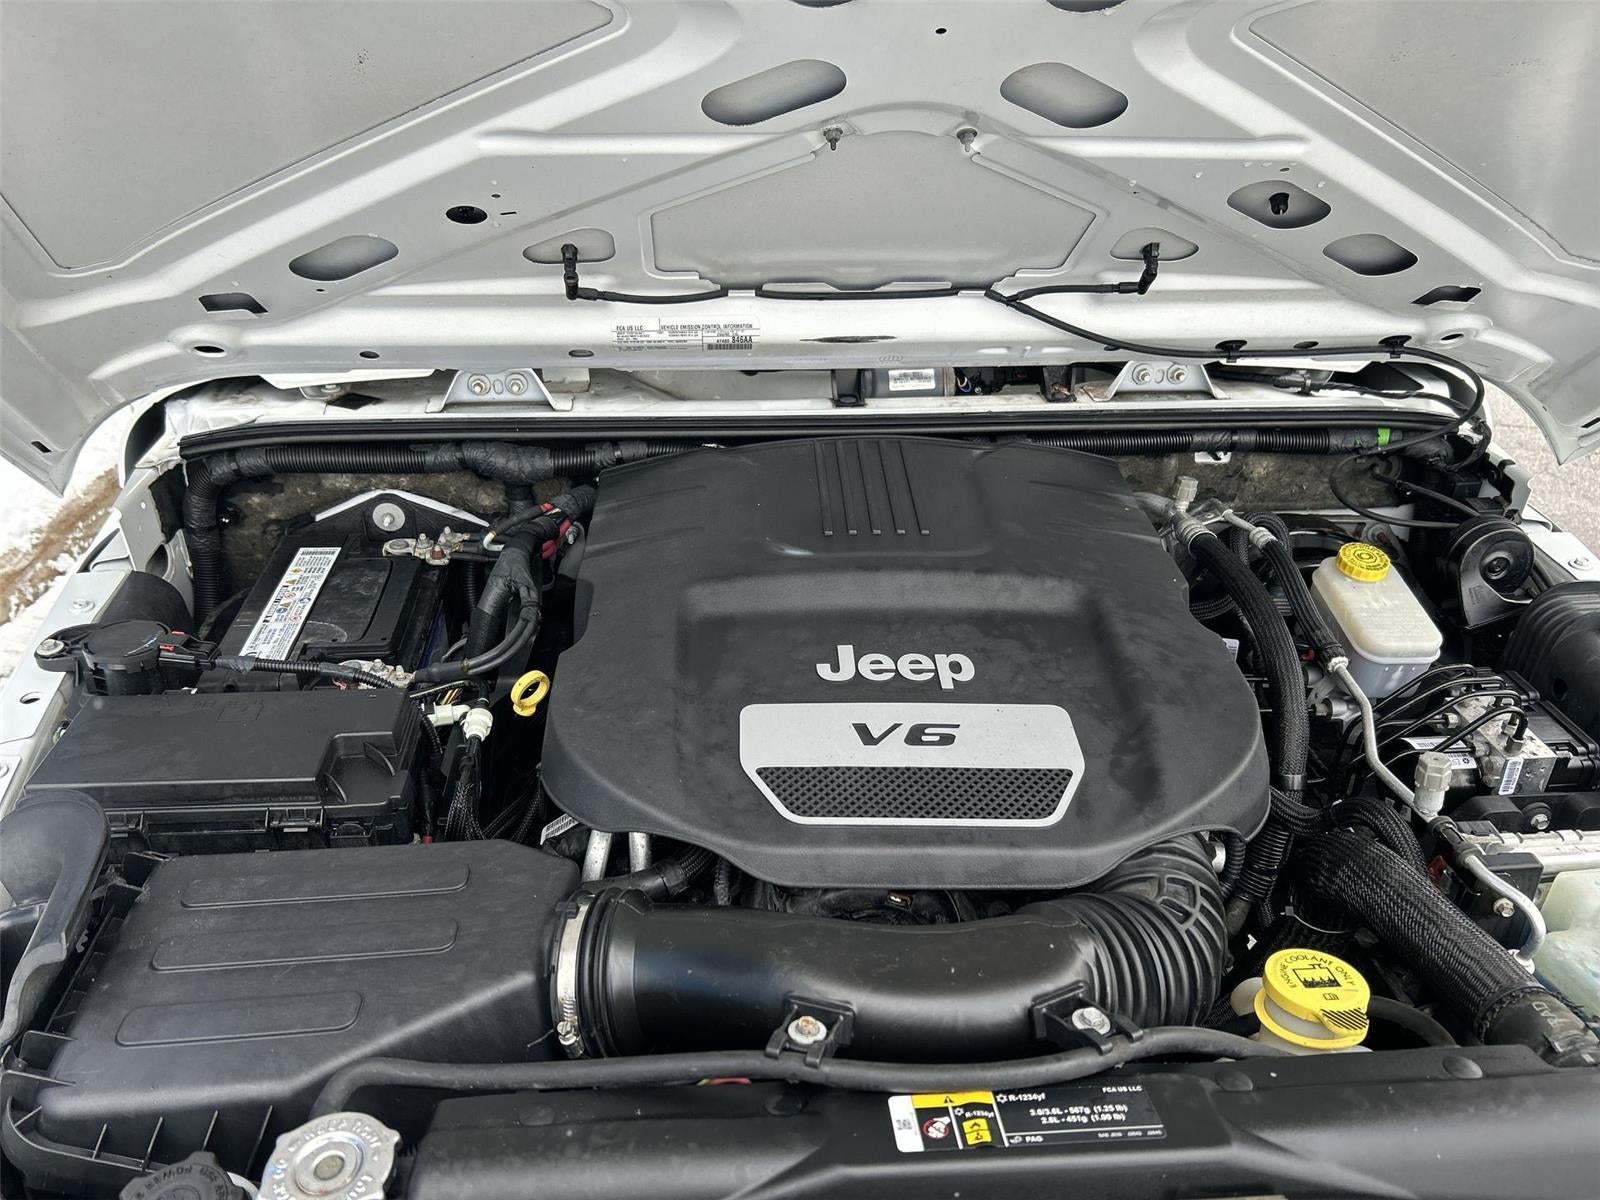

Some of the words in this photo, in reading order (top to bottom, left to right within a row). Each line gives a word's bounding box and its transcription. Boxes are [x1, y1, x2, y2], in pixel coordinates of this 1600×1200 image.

[731, 335, 753, 343] 846AA
[815, 644, 976, 690] Jeep
[851, 722, 961, 747] V6
[1284, 954, 1334, 966] COOLANT
[1335, 966, 1357, 986] ONLY
[1102, 1086, 1117, 1094] FCA
[1128, 1085, 1143, 1093] LLC
[1008, 1092, 1046, 1102] R-1234yf
[1025, 1135, 1044, 1143] PAG
